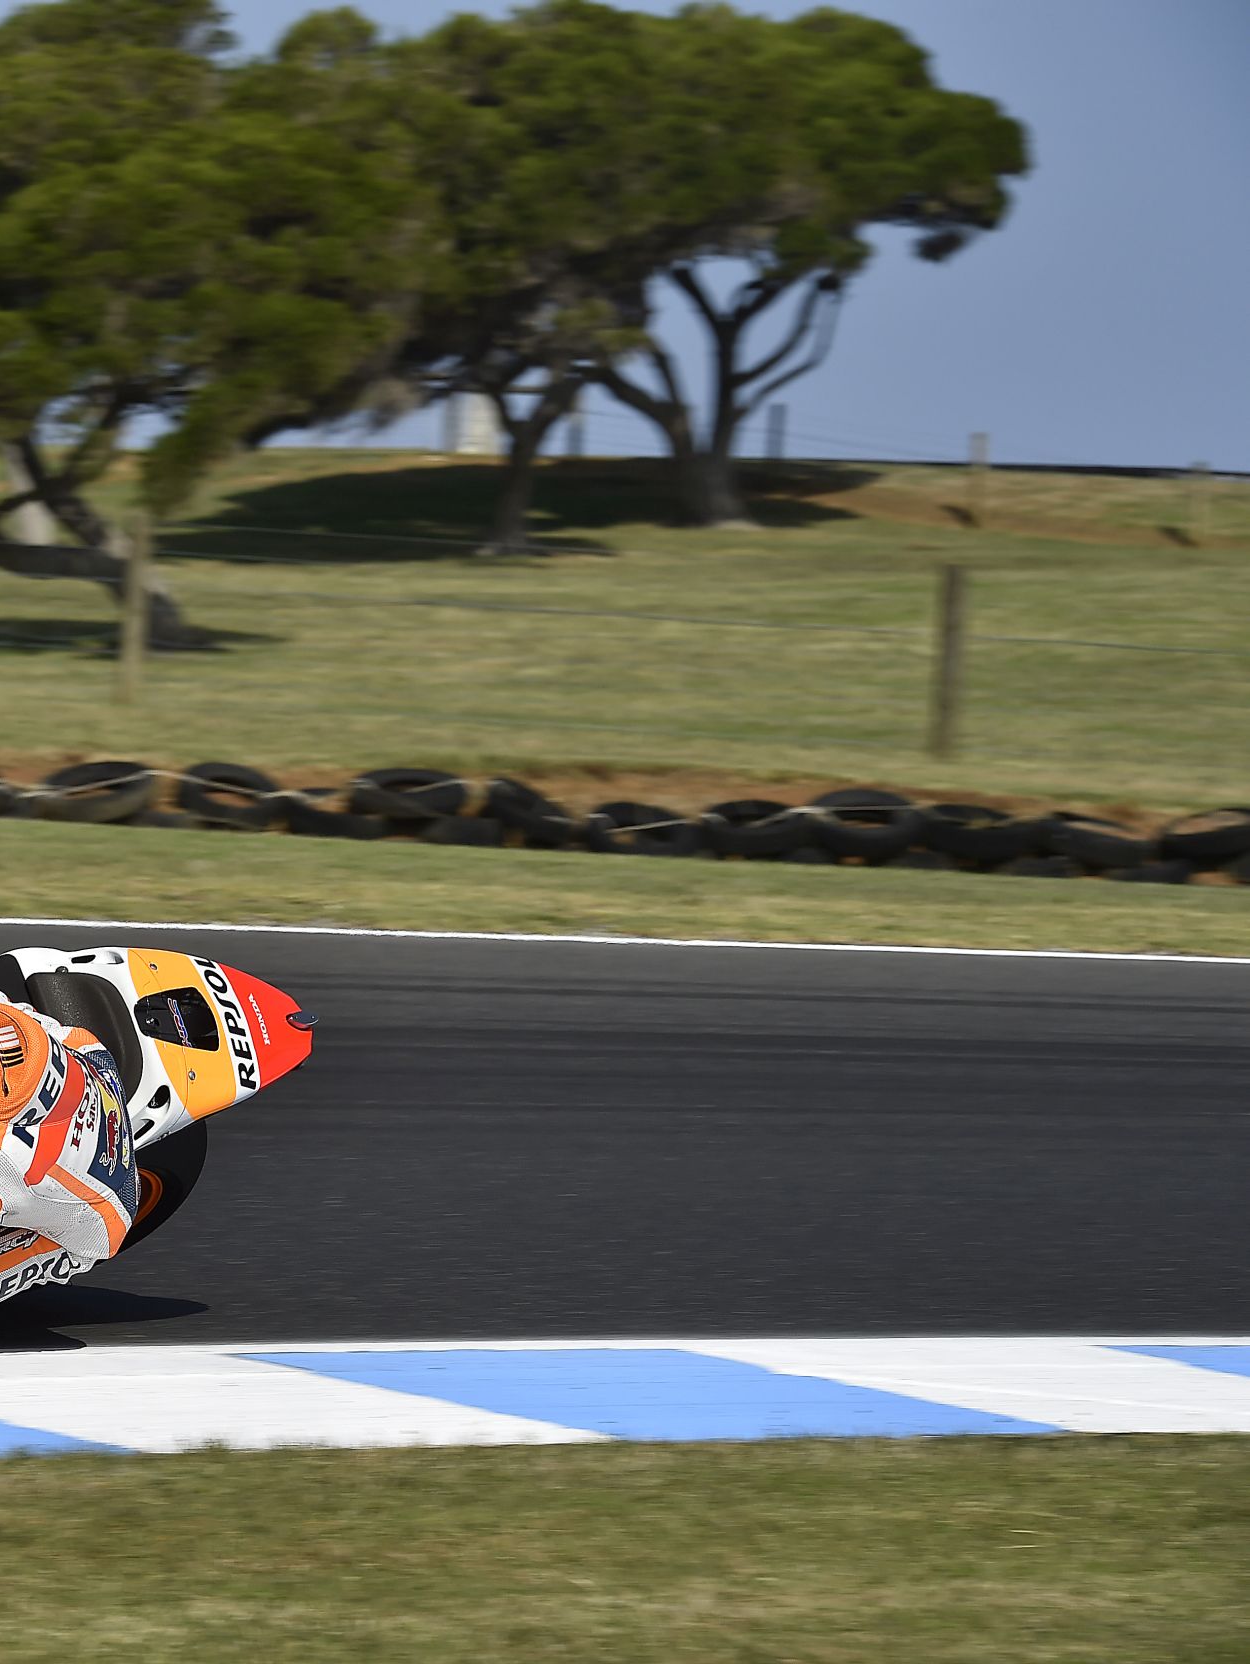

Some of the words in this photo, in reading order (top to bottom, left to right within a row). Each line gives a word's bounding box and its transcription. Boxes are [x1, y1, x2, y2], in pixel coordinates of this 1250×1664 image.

[194, 957, 257, 1091] REPSOL
[249, 993, 271, 1046] HONDA
[12, 1033, 67, 1149] REP
